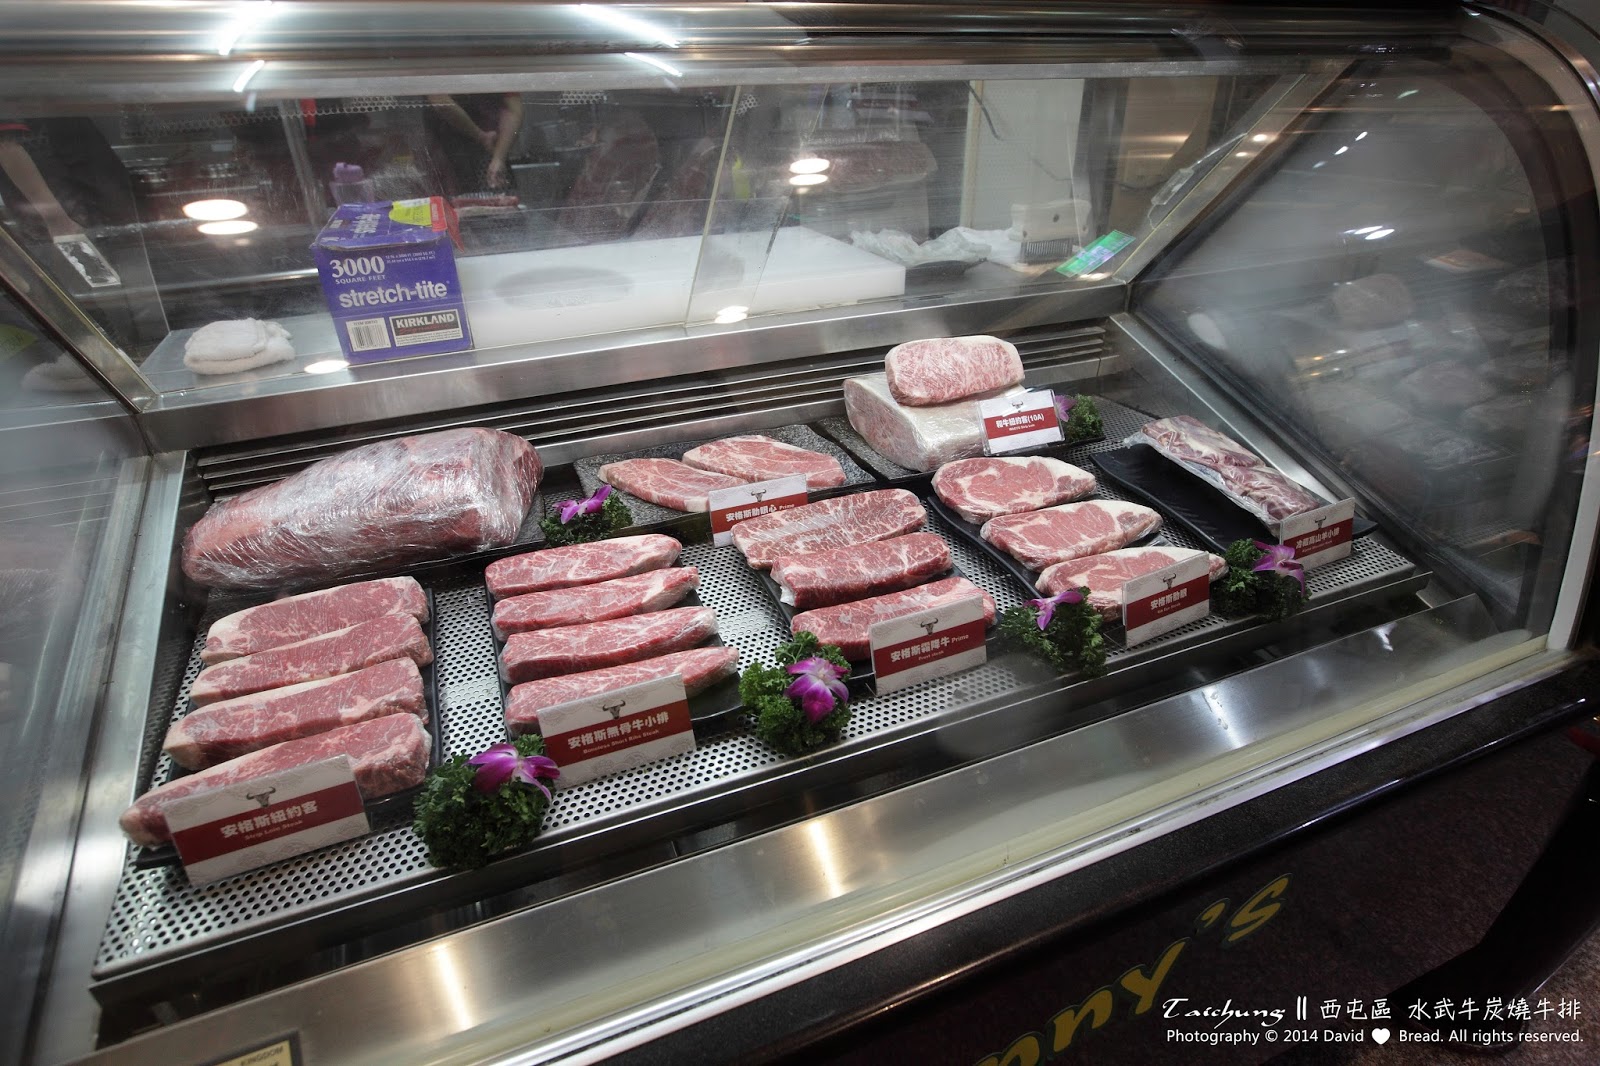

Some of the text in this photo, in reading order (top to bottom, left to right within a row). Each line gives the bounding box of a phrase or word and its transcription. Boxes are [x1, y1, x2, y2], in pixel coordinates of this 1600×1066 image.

[329, 255, 386, 278] 3000
[335, 275, 366, 285] SQUARE
[340, 280, 448, 308] stretch-tite
[395, 313, 455, 328] KIRKLAND
[779, 503, 795, 511] Prime
[890, 634, 969, 662] 安格斯霜降牛 Prime
[567, 711, 669, 749] 安格斯無骨牛小排
[642, 729, 659, 737] Steak
[220, 800, 318, 838] 安格斯紐約客
[244, 820, 303, 840] Strip Loin Steak
